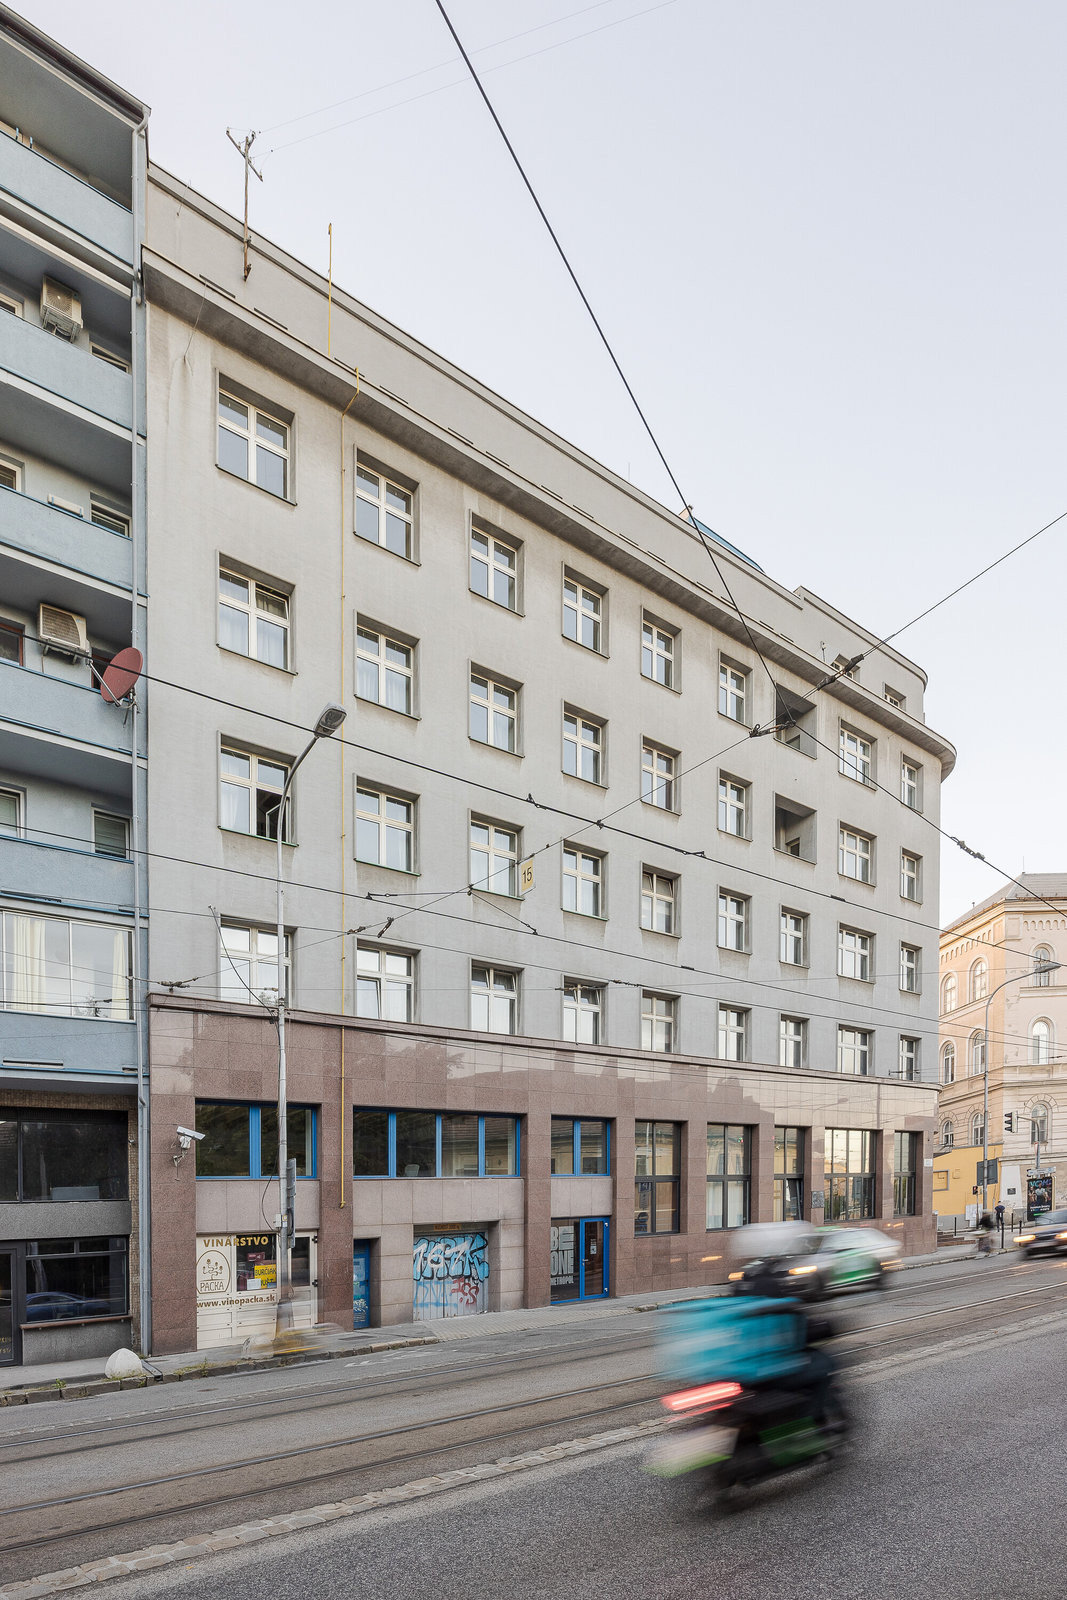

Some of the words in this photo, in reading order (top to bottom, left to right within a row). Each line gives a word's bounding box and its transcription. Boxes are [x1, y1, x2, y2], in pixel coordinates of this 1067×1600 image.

[522, 866, 533, 884] 15
[203, 1236, 268, 1247] VINÁRSTVO
[550, 1225, 574, 1251] BE
[550, 1250, 574, 1276] ONE
[200, 1281, 225, 1292] PACKA
[197, 1294, 275, 1308] www.vinopacka.sk
